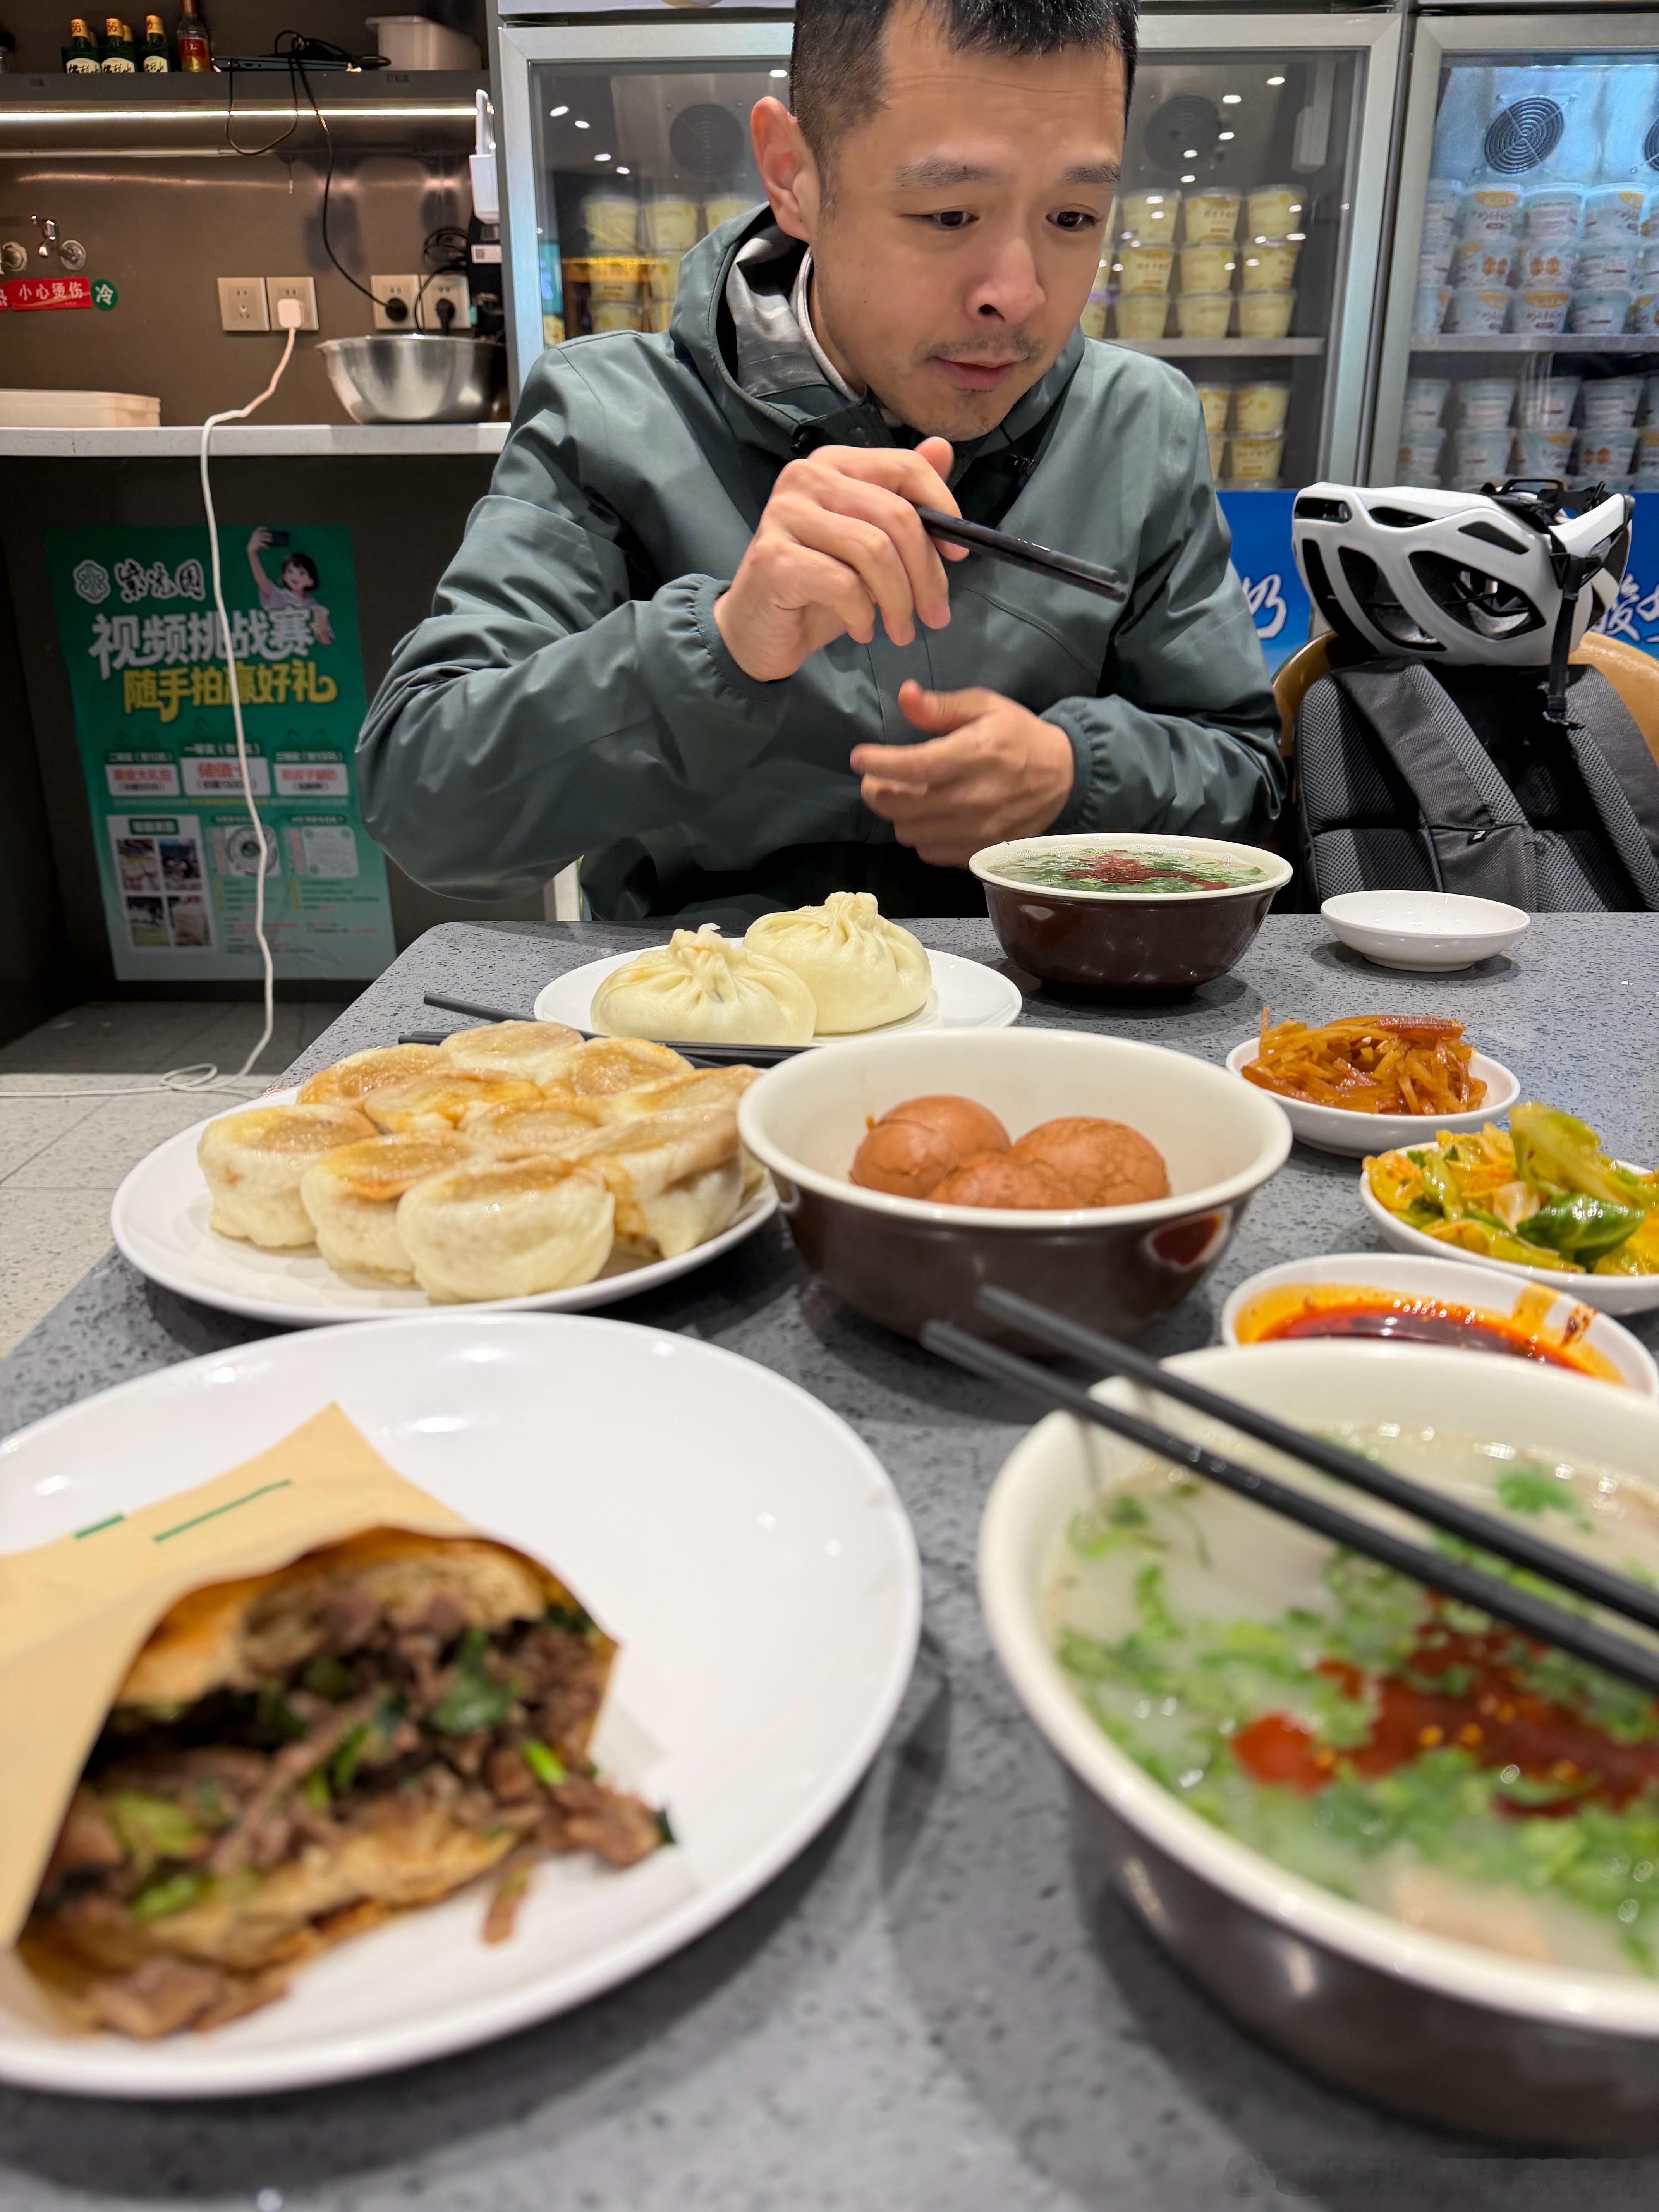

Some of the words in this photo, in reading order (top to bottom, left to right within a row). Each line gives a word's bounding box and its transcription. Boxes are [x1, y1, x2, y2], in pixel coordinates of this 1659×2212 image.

[19, 282, 83, 301] 小心烫伤
[95, 284, 113, 305] 冷
[89, 608, 314, 680] 视频挑战赛
[124, 663, 337, 722] 随手拍赢好礼
